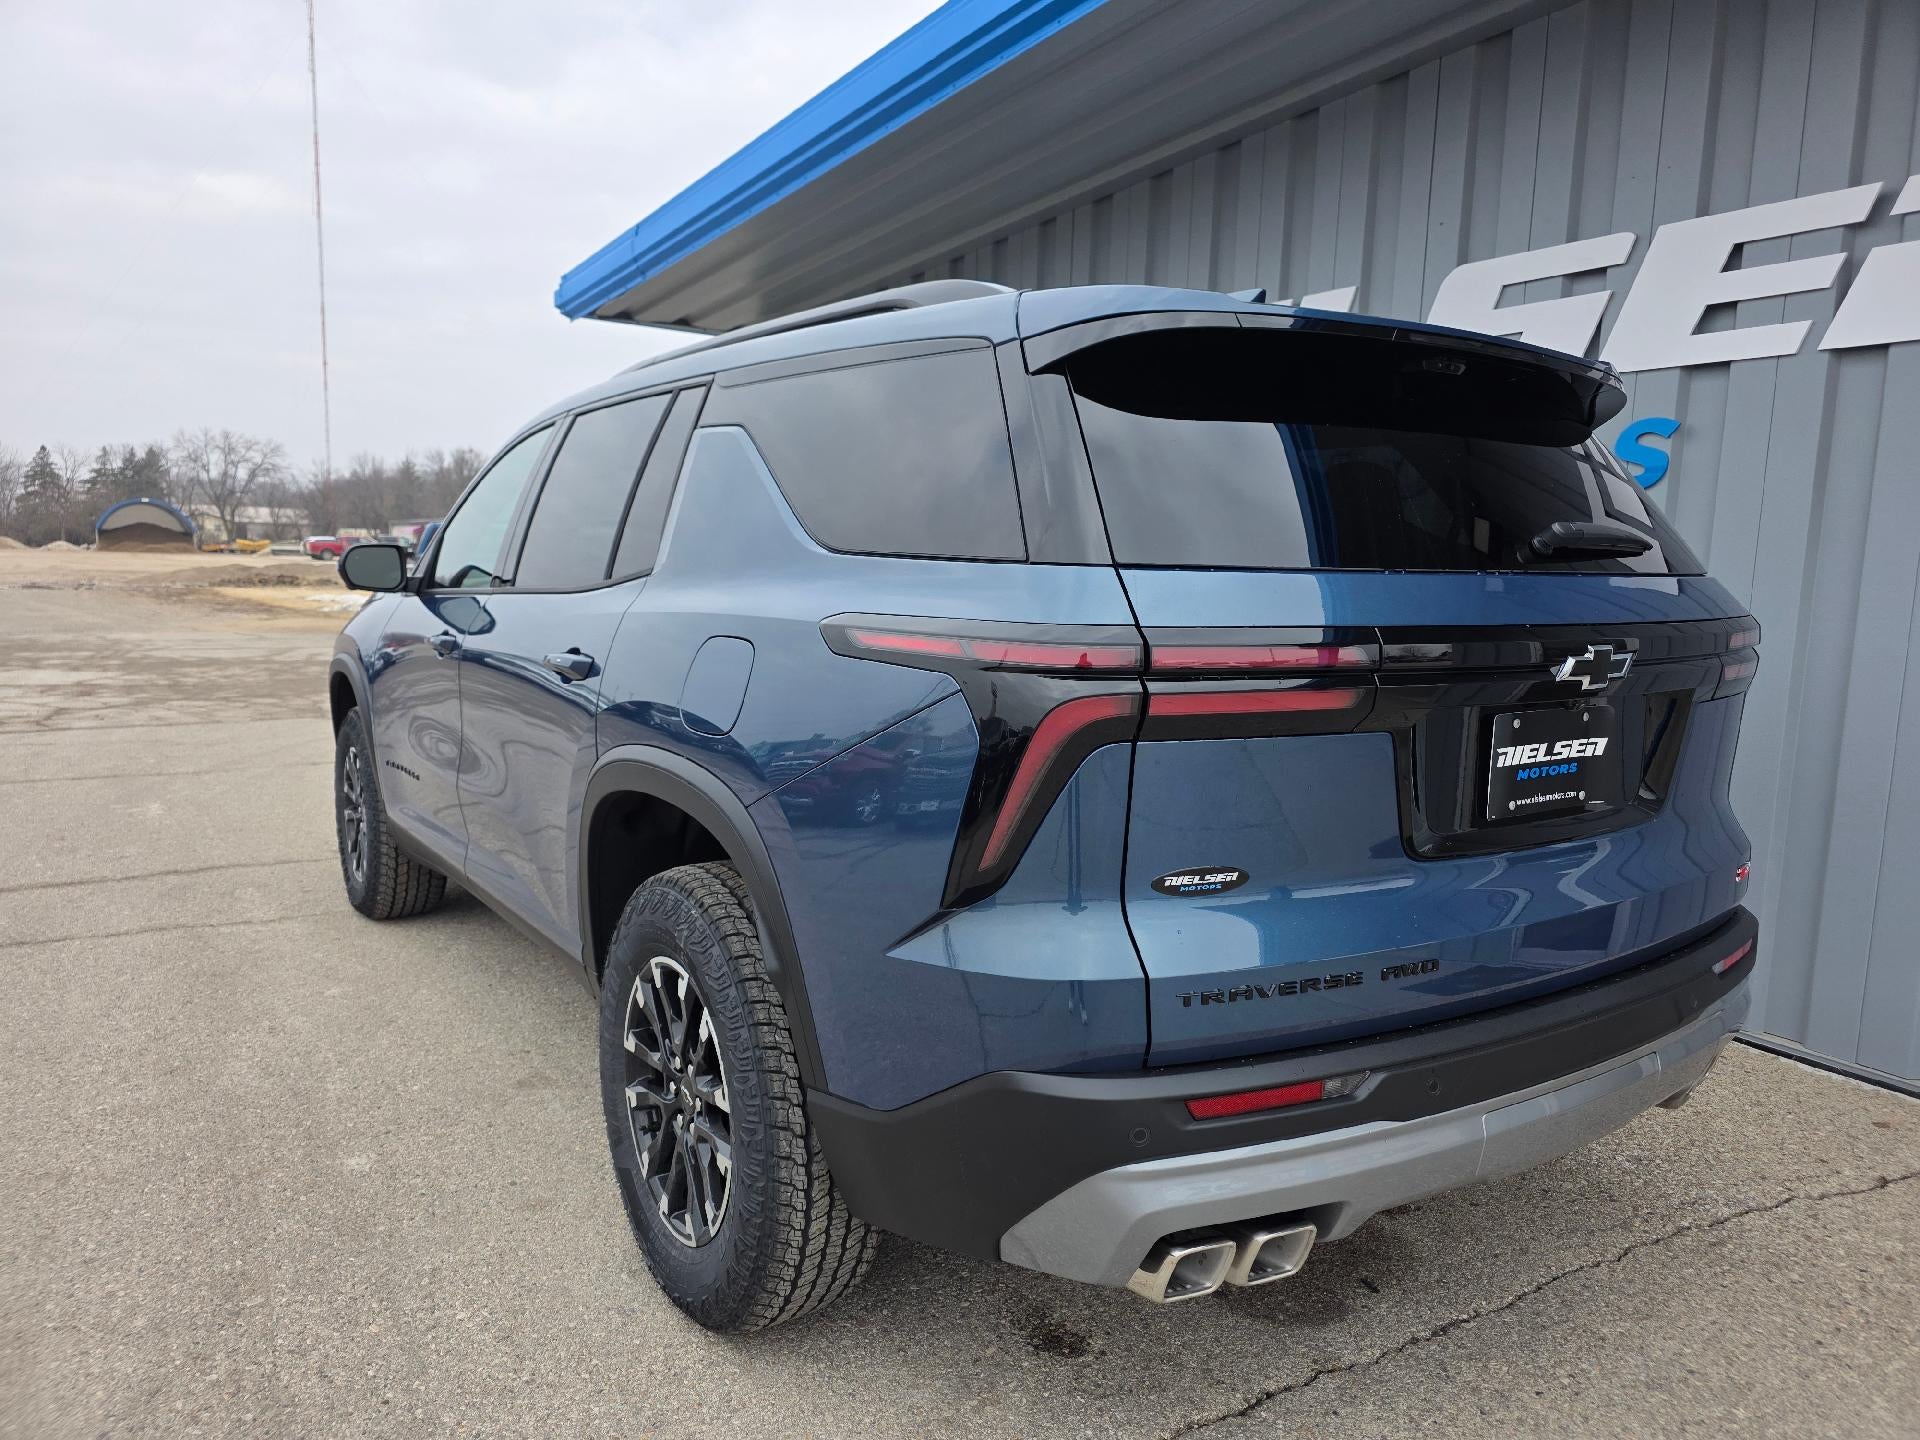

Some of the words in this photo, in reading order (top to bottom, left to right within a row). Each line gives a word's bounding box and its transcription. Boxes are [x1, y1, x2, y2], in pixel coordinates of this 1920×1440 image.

[1497, 737, 1608, 768] NIELSEN
[1516, 762, 1578, 781] MOTORS
[1163, 871, 1239, 887] NIELSEN
[1179, 883, 1232, 892] MOTORS
[1175, 970, 1364, 1008] TRAVERSE
[1380, 957, 1440, 982] AWD
